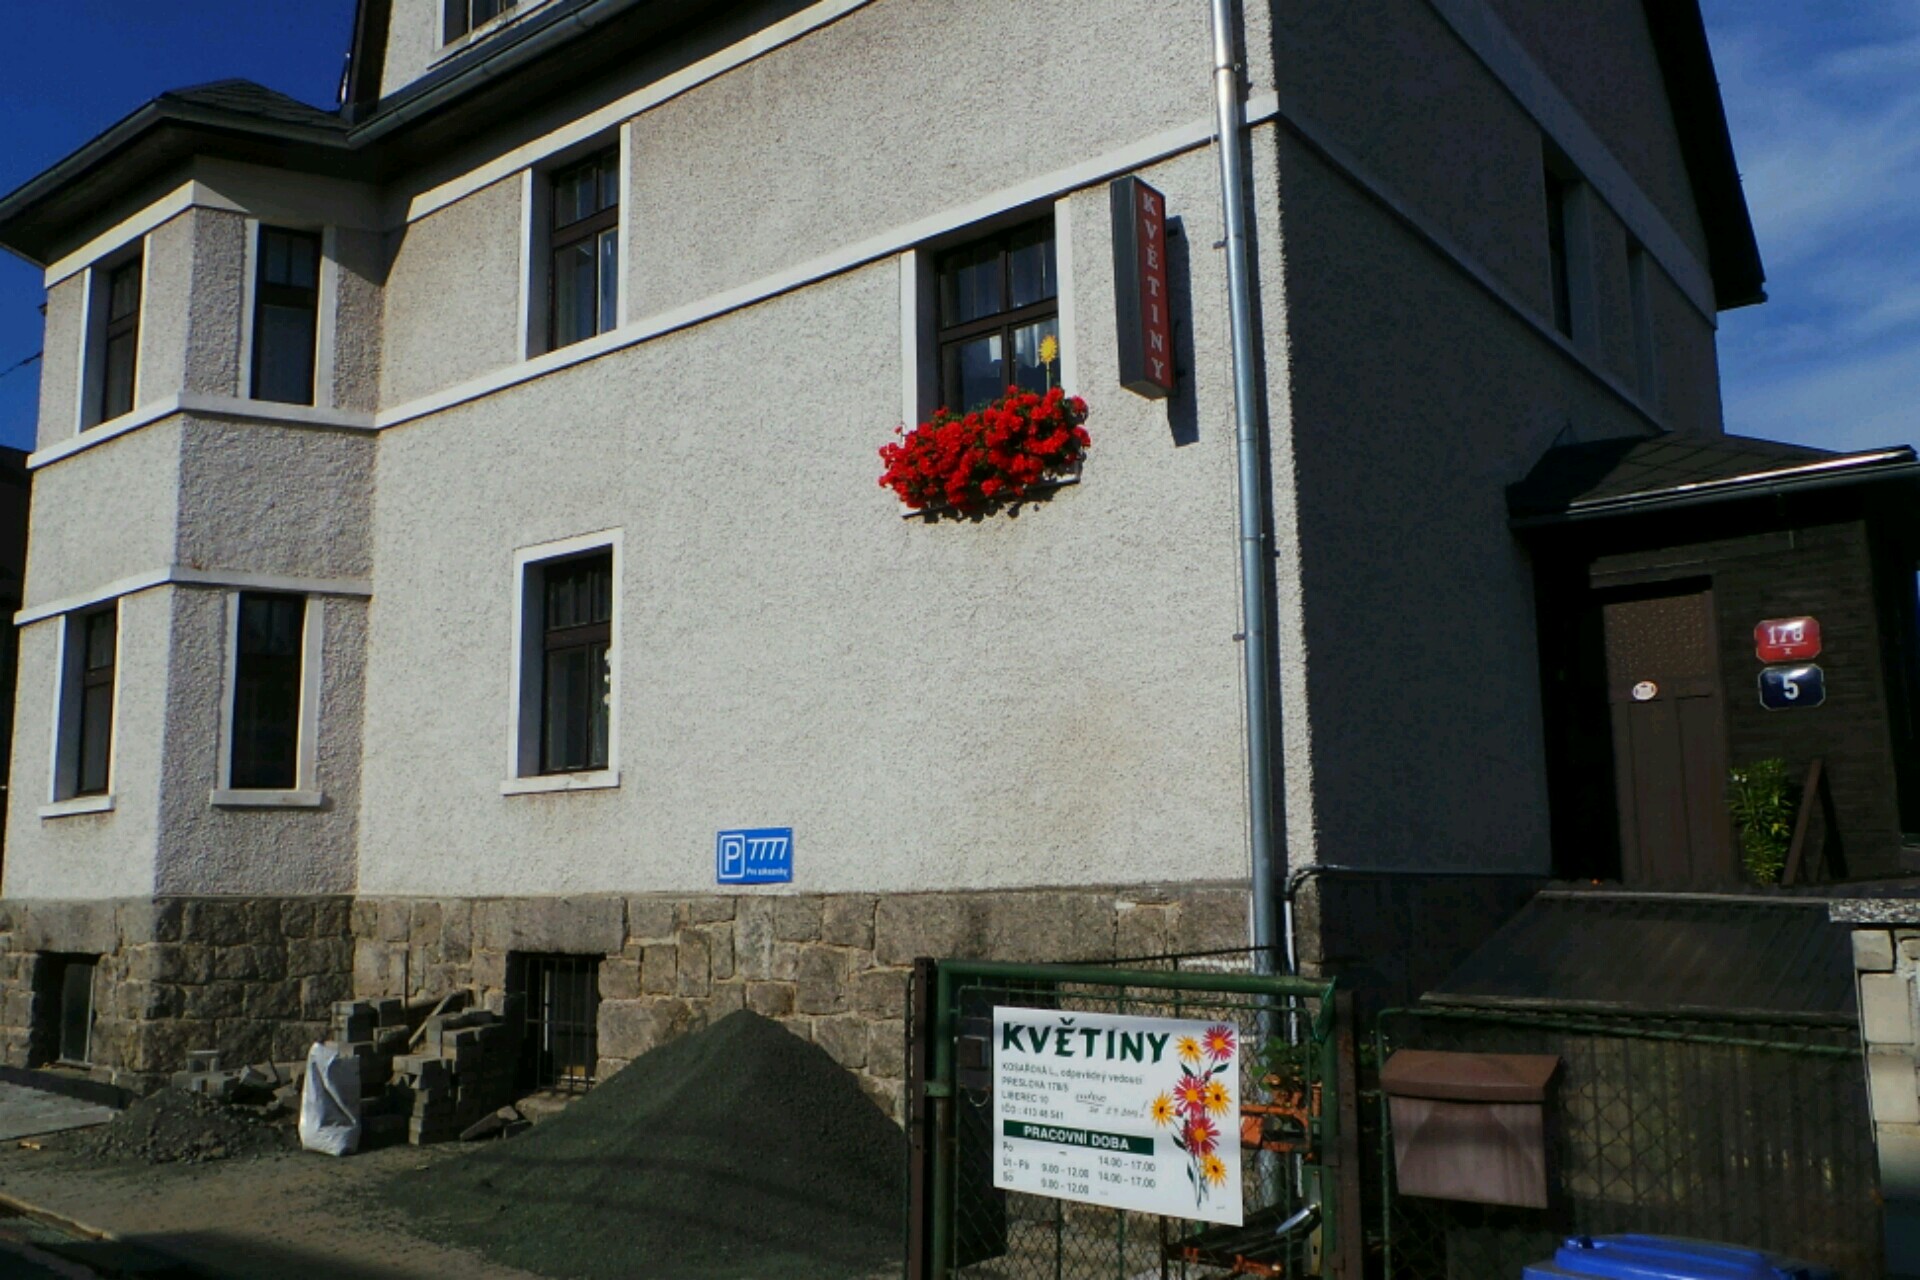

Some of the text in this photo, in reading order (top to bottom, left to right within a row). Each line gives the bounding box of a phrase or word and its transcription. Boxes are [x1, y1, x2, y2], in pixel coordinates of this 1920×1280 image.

[1142, 192, 1163, 380] KVĚTINY
[1768, 625, 1804, 645] 178
[1783, 673, 1799, 699] 5
[724, 841, 740, 872] P
[1002, 1017, 1170, 1064] KVĚTINY
[1001, 1090, 1037, 1103] LIBEREC
[1023, 1125, 1130, 1151] PRACOVNÍ DOBA
[1003, 1141, 1014, 1152] Po
[1098, 1155, 1122, 1169] 14.00
[1131, 1160, 1156, 1173] 17.00
[1041, 1162, 1060, 1175] 9.00
[1067, 1167, 1089, 1179] 12.00
[1098, 1171, 1122, 1184] 14.00
[1131, 1176, 1156, 1189] 17.00
[1041, 1178, 1060, 1190] 9.00
[1067, 1182, 1089, 1195] 12.00
